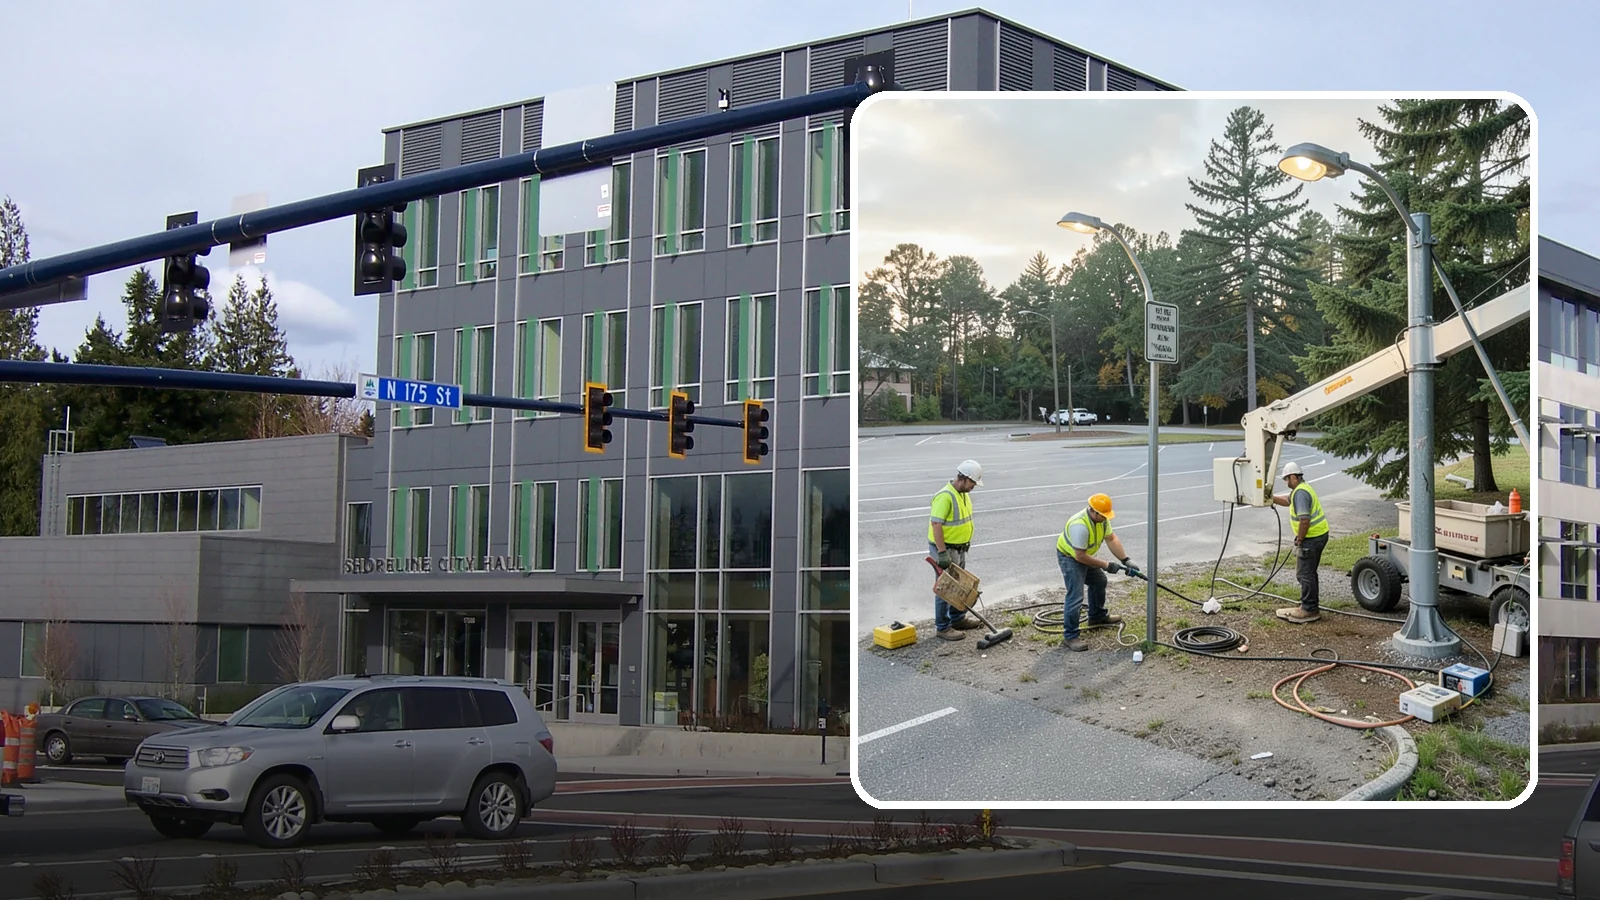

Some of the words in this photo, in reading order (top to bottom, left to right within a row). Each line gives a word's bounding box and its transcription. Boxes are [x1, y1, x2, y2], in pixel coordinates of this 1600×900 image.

[387, 380, 396, 400] N
[405, 382, 428, 403] 175
[436, 386, 452, 406] St
[344, 556, 432, 574] SHORELINE
[438, 556, 476, 573] CITY
[483, 555, 525, 572] HALL
